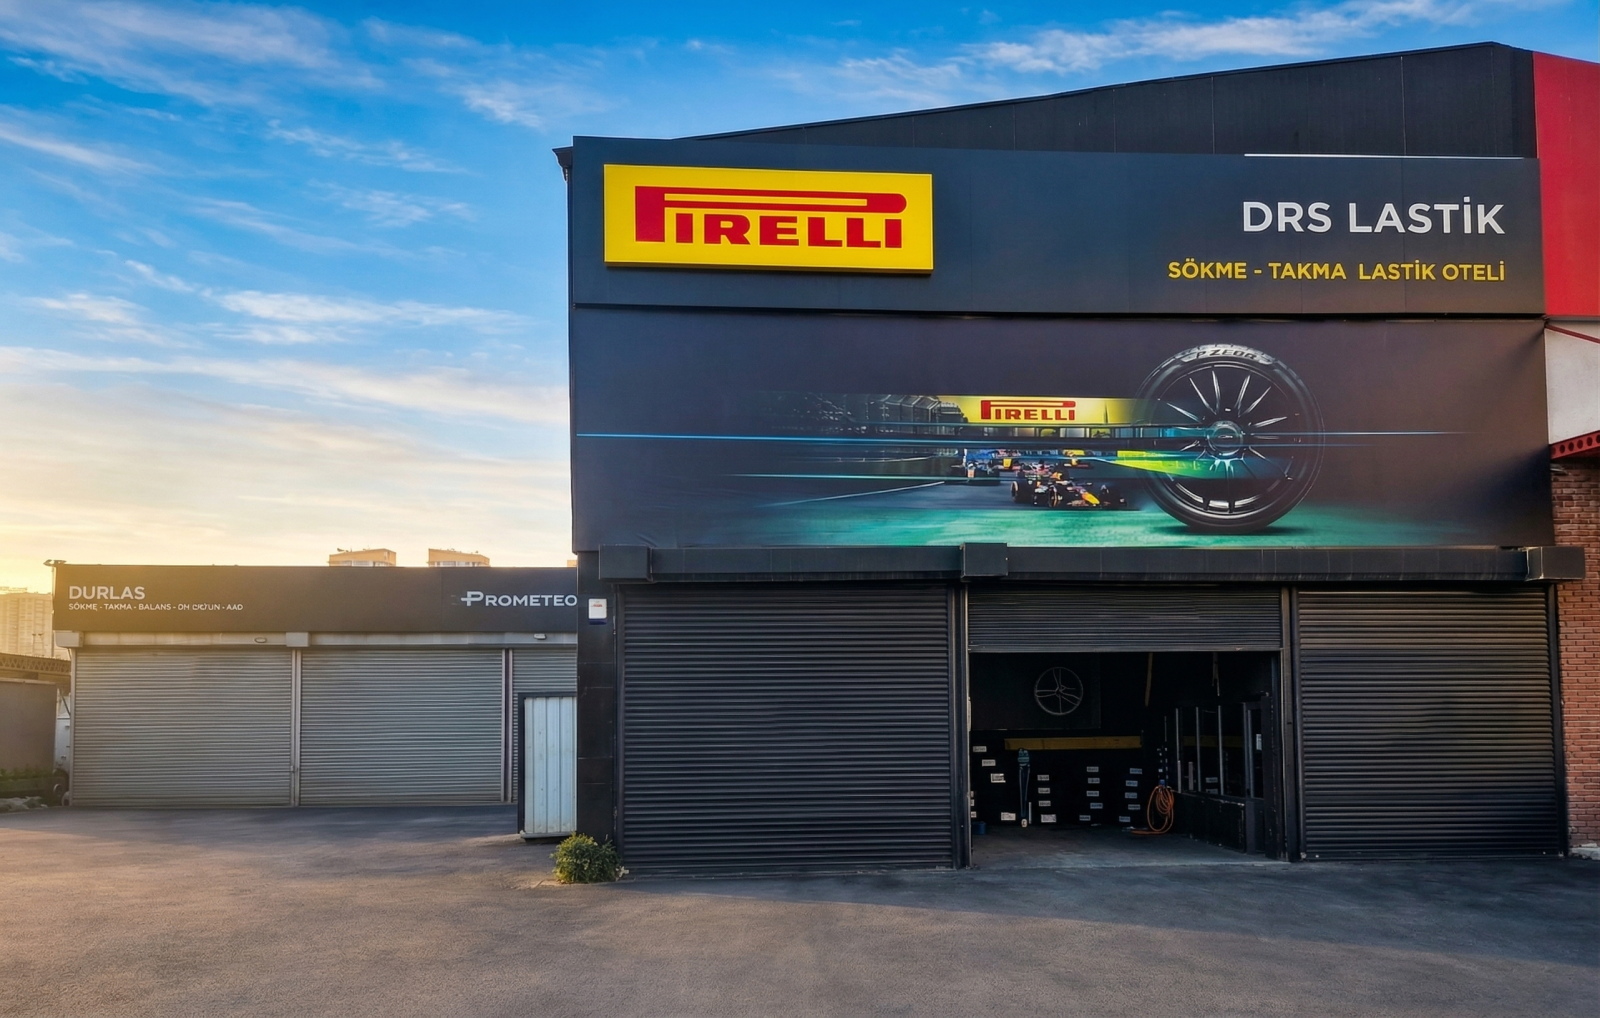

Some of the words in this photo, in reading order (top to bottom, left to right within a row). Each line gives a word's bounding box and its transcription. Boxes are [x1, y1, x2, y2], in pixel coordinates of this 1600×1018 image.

[635, 186, 907, 249] PIRELLI
[1243, 201, 1332, 233] DRS
[1348, 196, 1506, 234] LASTİK
[1168, 257, 1247, 280] SÖKME
[1268, 262, 1347, 280] TAKMA
[1358, 259, 1437, 281] LASTİK
[1441, 260, 1505, 281] OTELİ
[981, 400, 1076, 420] PIRELLI
[68, 586, 146, 600] DURLAS
[104, 603, 132, 611] TAKMA
[138, 603, 171, 611] BALANS
